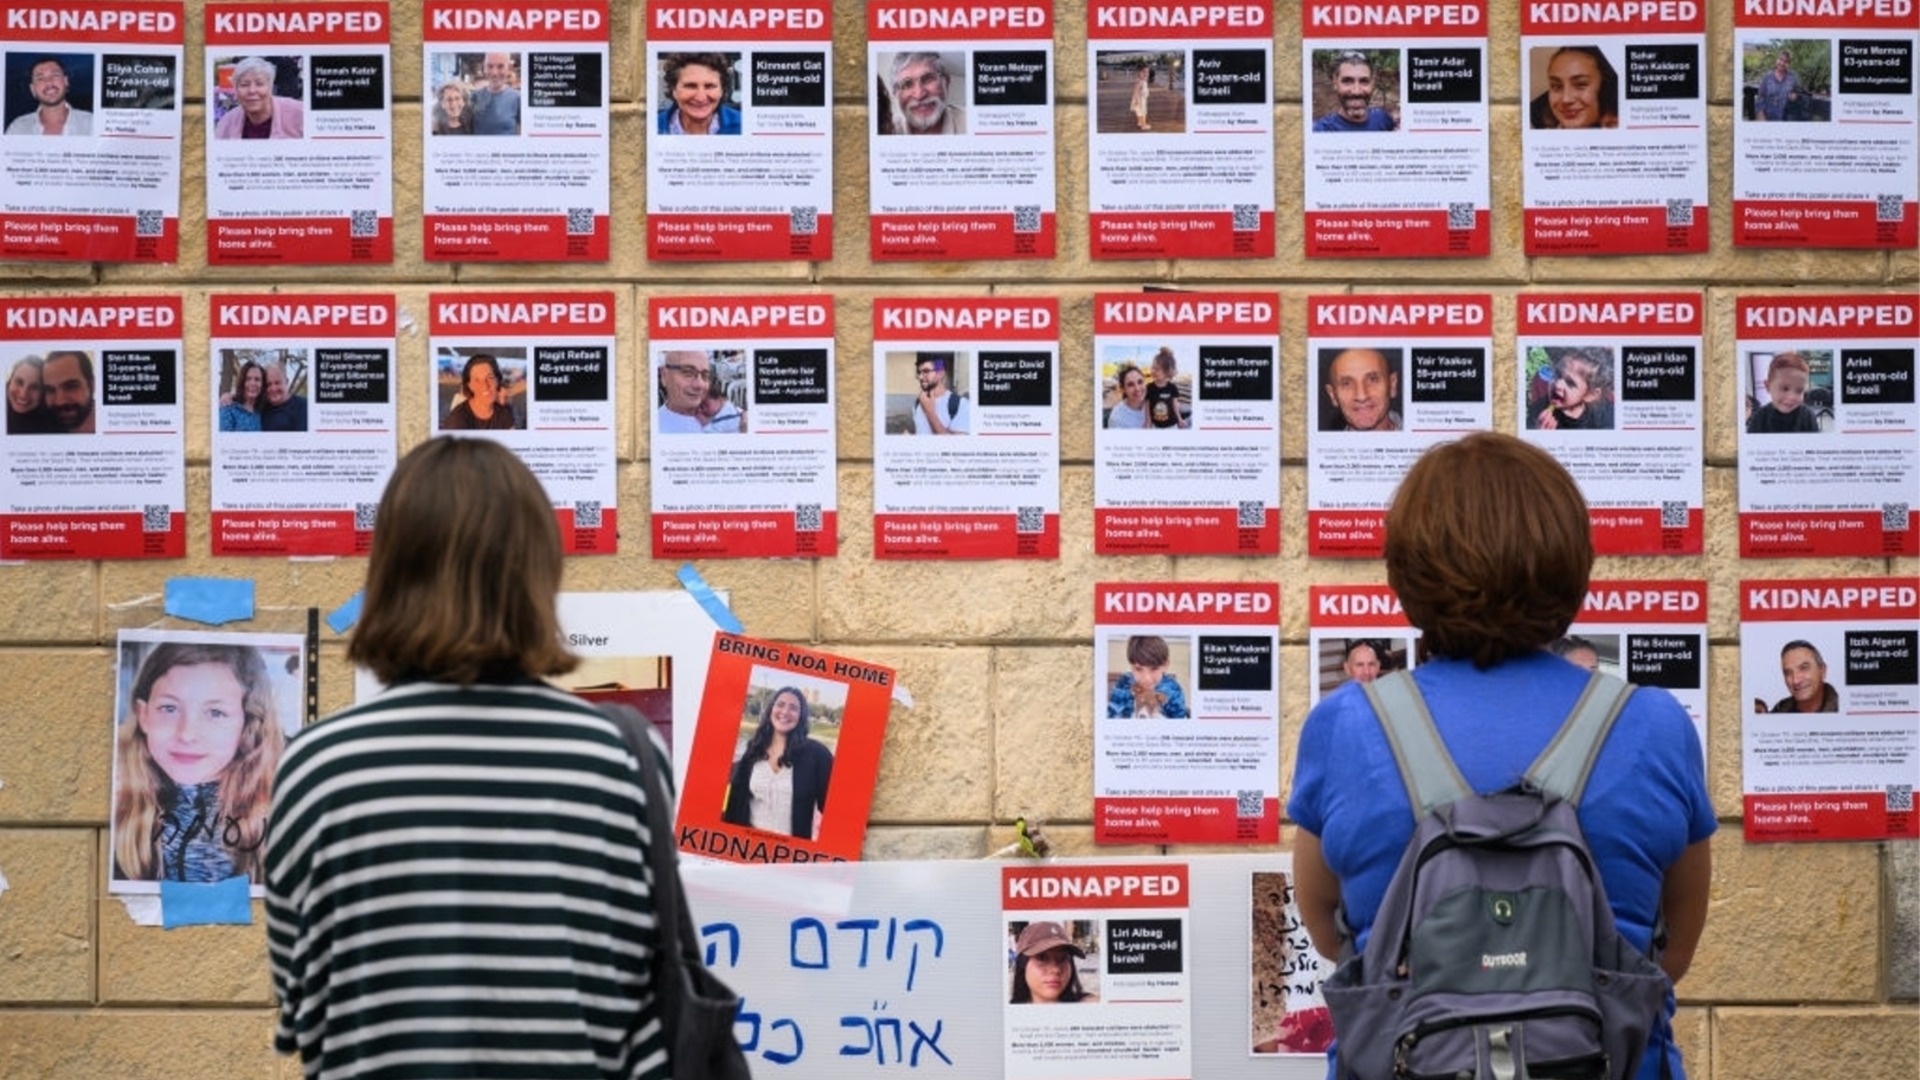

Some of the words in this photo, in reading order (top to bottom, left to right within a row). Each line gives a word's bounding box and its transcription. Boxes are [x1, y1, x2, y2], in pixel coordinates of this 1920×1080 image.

[657, 8, 823, 29] KIDNAPPED
[878, 6, 1044, 29] KIDNAPPED
[1098, 5, 1264, 27] KIDNAPPED
[1313, 4, 1479, 26] KIDNAPPED
[1531, 1, 1696, 23] KIDNAPPED
[1745, 0, 1911, 17] KIDNAPPED
[8, 8, 175, 33] KIDNAPPED
[215, 11, 381, 33] KIDNAPPED
[434, 9, 600, 30] KIDNAPPED
[5, 223, 38, 231] Please
[41, 223, 62, 233] help
[65, 223, 91, 234] bring
[94, 224, 118, 232] them
[658, 223, 691, 231] Please
[694, 223, 715, 233] help
[718, 223, 744, 233] bring
[747, 223, 772, 231] them
[1101, 221, 1133, 229] Please
[1136, 221, 1157, 231] help
[1161, 221, 1187, 231] bring
[1190, 220, 1215, 229] them
[658, 235, 686, 243] home
[1101, 234, 1129, 242] home
[7, 306, 174, 328] KIDNAPPED
[221, 305, 387, 326] KIDNAPPED
[439, 303, 606, 324] KIDNAPPED
[659, 305, 825, 328] KIDNAPPED
[883, 307, 1050, 329] KIDNAPPED
[1105, 302, 1271, 323] KIDNAPPED
[1318, 304, 1483, 326] KIDNAPPED
[1528, 303, 1693, 324] KIDNAPPED
[1747, 305, 1912, 327] KIDNAPPED
[884, 522, 917, 530] Please
[920, 522, 941, 532] help
[945, 522, 971, 533] bring
[974, 522, 998, 530] them
[884, 535, 912, 543] home
[1105, 592, 1271, 613] KIDNAPPED
[1320, 594, 1402, 615] KIDNA
[1584, 591, 1699, 611] NAPPED
[1750, 587, 1916, 609] KIDNAPPED
[569, 633, 608, 646] Silver
[718, 638, 781, 662] BRING
[786, 652, 828, 673] NOA
[834, 662, 889, 686] HOME
[1105, 806, 1137, 814] Please
[1141, 806, 1161, 816] help
[1164, 806, 1191, 816] bring
[1194, 806, 1219, 814] them
[1754, 803, 1787, 811] Please
[1790, 802, 1811, 813] help
[1814, 802, 1839, 812] bring
[1843, 801, 1867, 809] them
[1105, 818, 1133, 827] home
[1754, 815, 1781, 823] home
[680, 825, 847, 864] KIDNAPP
[1010, 875, 1179, 898] KIDNAPPED
[791, 917, 944, 991] קודם
[1482, 952, 1527, 967] OUTDOOR
